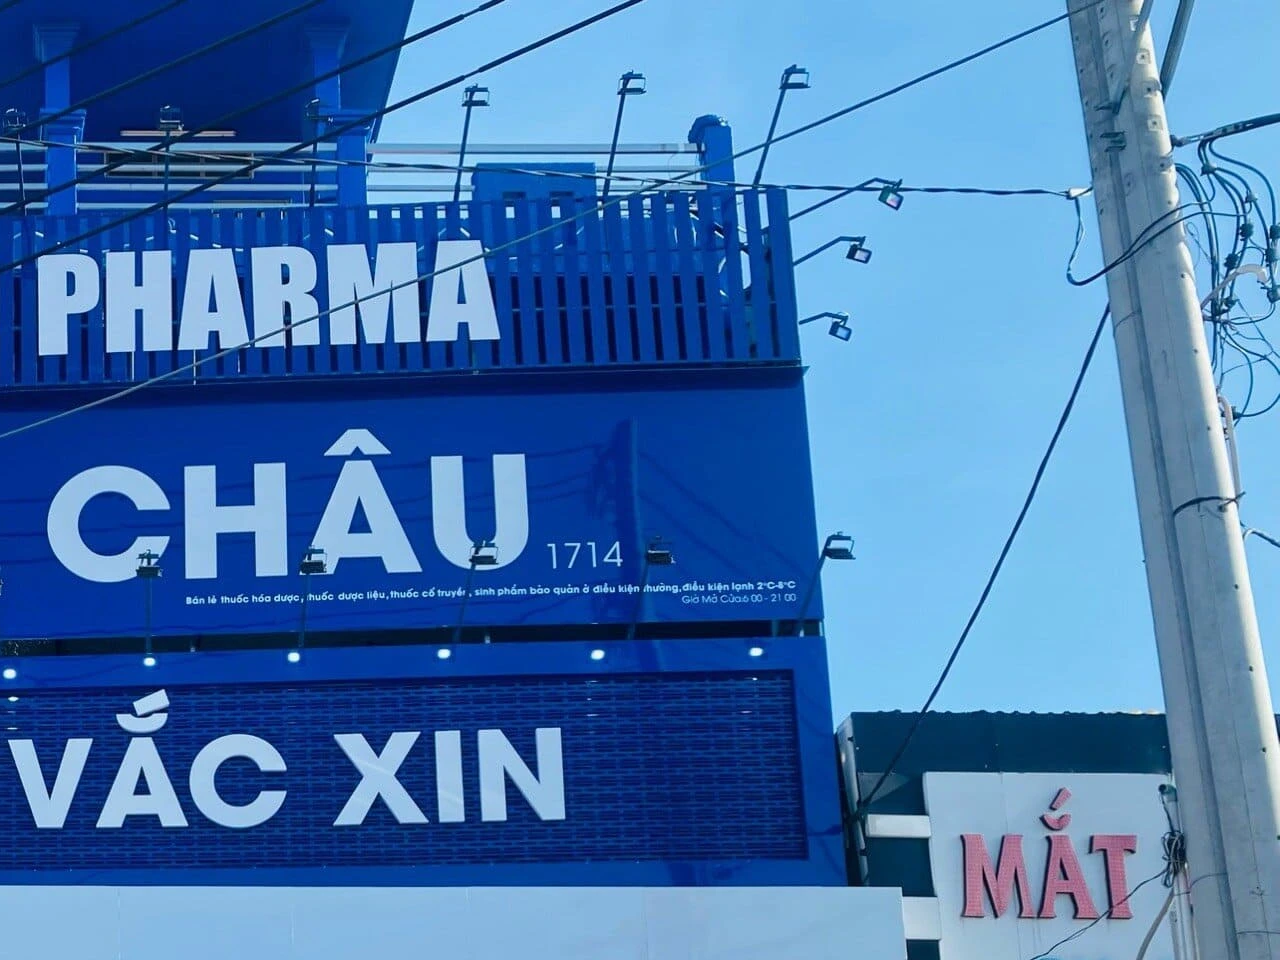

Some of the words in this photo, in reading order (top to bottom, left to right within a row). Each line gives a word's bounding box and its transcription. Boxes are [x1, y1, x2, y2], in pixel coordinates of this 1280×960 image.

[38, 239, 501, 357] PHARMA
[47, 428, 529, 582] CHÂU
[547, 540, 623, 570] 1714
[8, 689, 287, 831] VẮC
[333, 727, 567, 827] XIN
[960, 787, 1137, 920] MẮT
